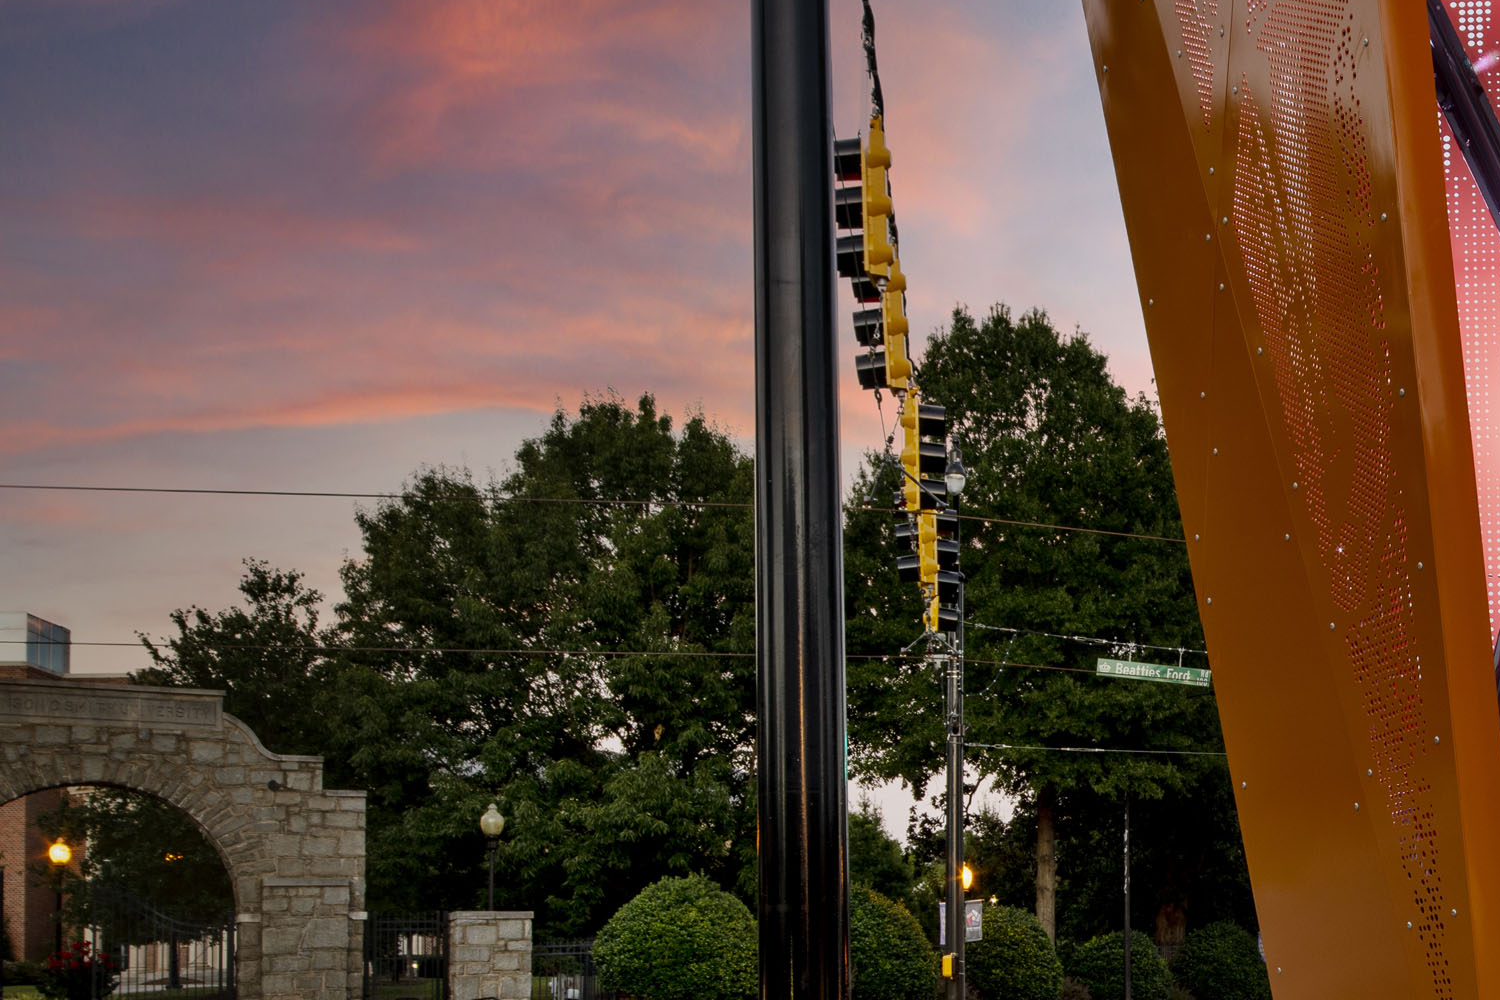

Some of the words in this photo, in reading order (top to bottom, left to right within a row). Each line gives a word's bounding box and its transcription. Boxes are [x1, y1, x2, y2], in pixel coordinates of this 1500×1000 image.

[1115, 663, 1161, 678] Beatties
[1166, 668, 1191, 681] Ford
[1200, 669, 1209, 678] Rd
